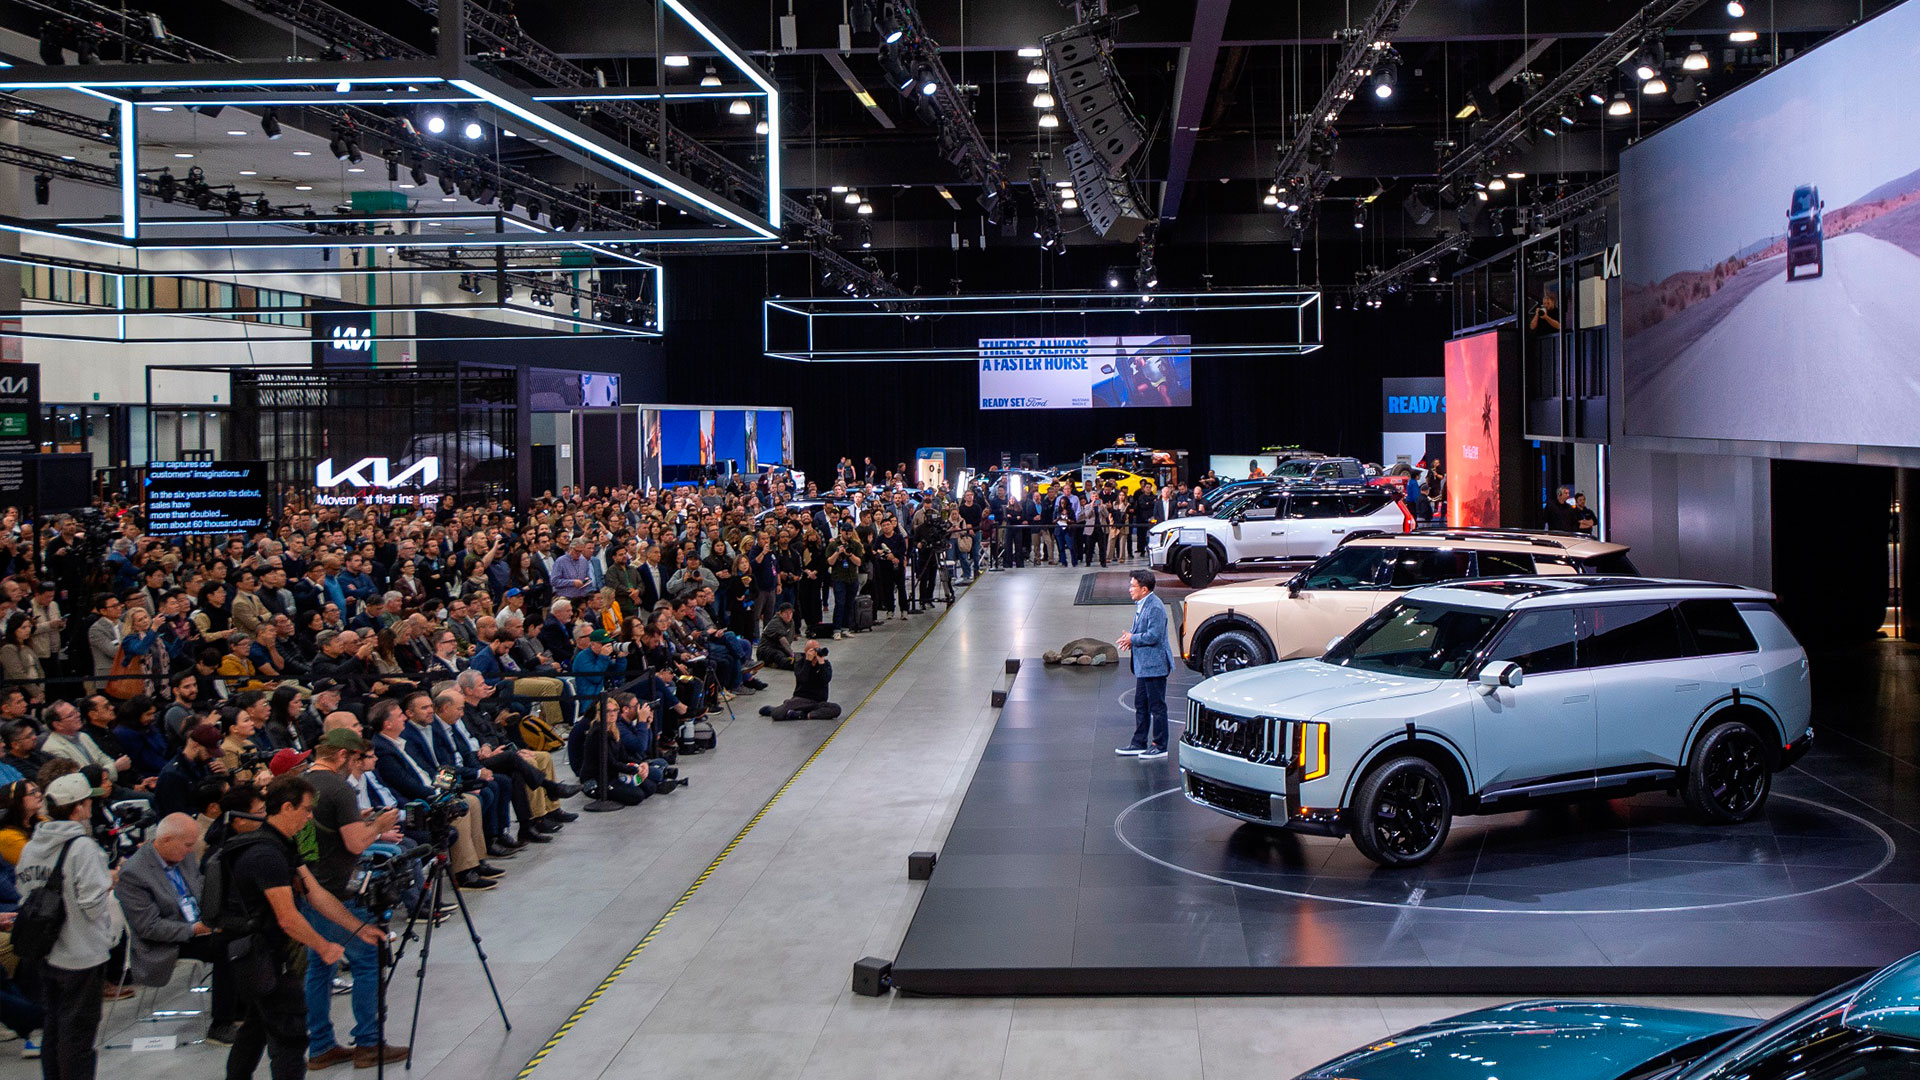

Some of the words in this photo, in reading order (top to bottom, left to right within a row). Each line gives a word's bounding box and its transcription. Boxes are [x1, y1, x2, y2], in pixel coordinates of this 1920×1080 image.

[981, 340, 1036, 355] THERE'S
[1039, 339, 1089, 354] ALWAYS
[982, 358, 992, 371] A
[994, 358, 1042, 371] FASTER
[1045, 357, 1088, 370] HORSE
[982, 398, 1009, 407] READY
[1010, 397, 1025, 407] SET
[1025, 397, 1048, 407] Ford
[1388, 396, 1439, 413] READY
[316, 456, 439, 489] KIA
[160, 490, 173, 498] the
[174, 490, 185, 498] six
[186, 490, 207, 500] years
[208, 489, 227, 497] since
[228, 489, 238, 497] its
[317, 495, 373, 505] Movemnt
[375, 494, 397, 504] that
[399, 494, 439, 504] insires
[150, 501, 171, 509] sales
[172, 501, 191, 509] have
[190, 510, 220, 518] doubled
[150, 522, 169, 530] from
[170, 521, 192, 529] about
[193, 520, 203, 528] 60
[204, 519, 238, 528] thousand
[239, 518, 257, 526] units
[1215, 717, 1239, 733] KIA
